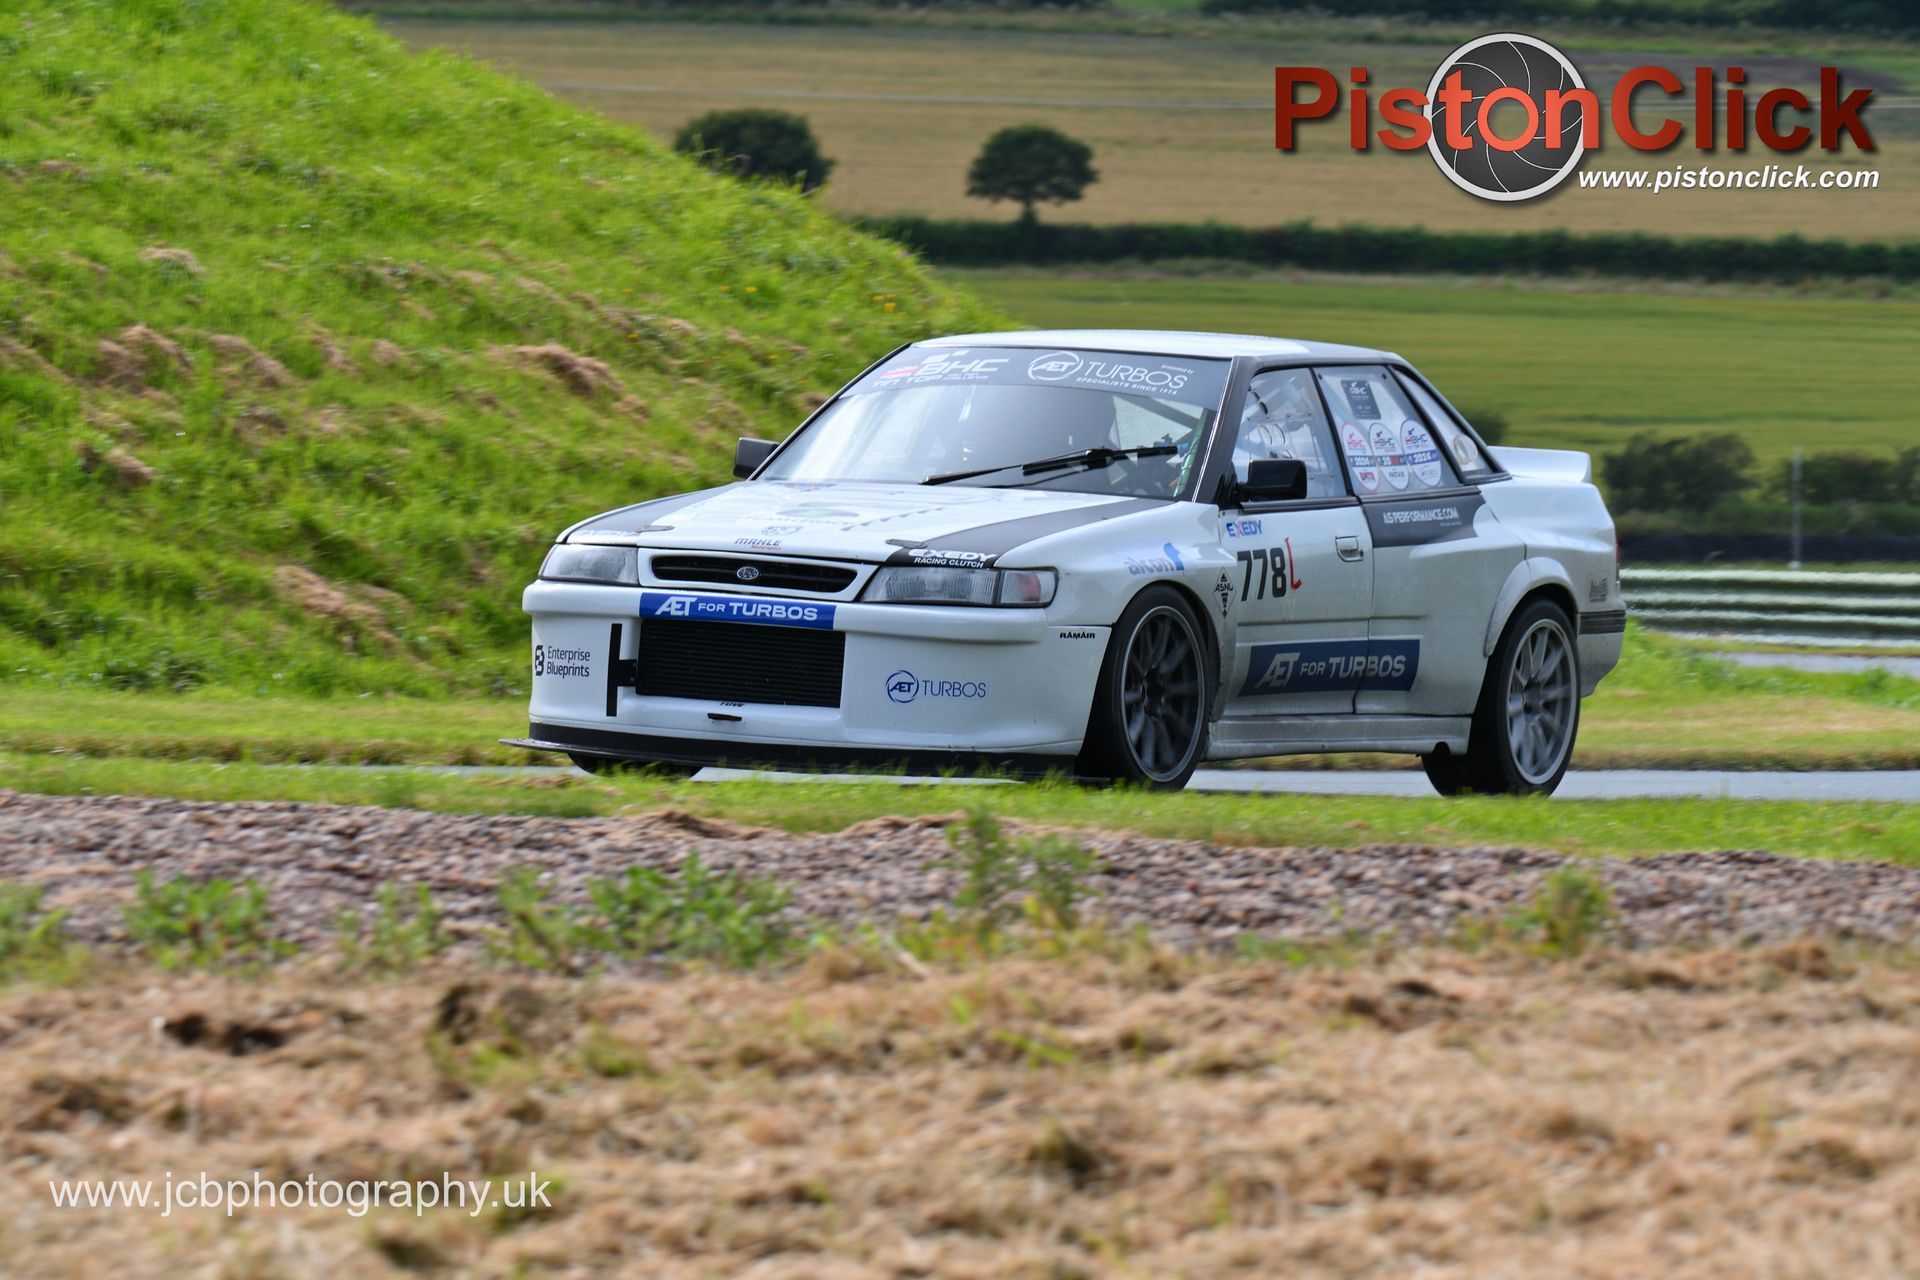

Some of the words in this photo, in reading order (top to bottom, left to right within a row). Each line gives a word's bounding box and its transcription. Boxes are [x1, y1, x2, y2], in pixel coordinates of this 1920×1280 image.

[1084, 361, 1188, 389] TURBOS
[1076, 377, 1130, 388] SPECIALISTS
[1131, 384, 1158, 392] SINCE
[1226, 520, 1263, 538] EXEDY
[734, 537, 783, 546] MAHLE
[908, 548, 997, 562] EXEDY
[914, 557, 947, 565] RACING
[949, 559, 985, 568] CLUTCH
[1237, 547, 1287, 602] 778
[655, 596, 698, 617] AET
[698, 602, 726, 613] FOR
[729, 601, 818, 621] TURBOS
[547, 645, 591, 664] Enterprise
[546, 661, 590, 679] Blueprints
[1254, 652, 1300, 689] AET
[1300, 661, 1326, 677] FOR
[1328, 655, 1407, 679] TURBOS
[889, 681, 915, 693] AET
[922, 680, 987, 698] TURBOS
